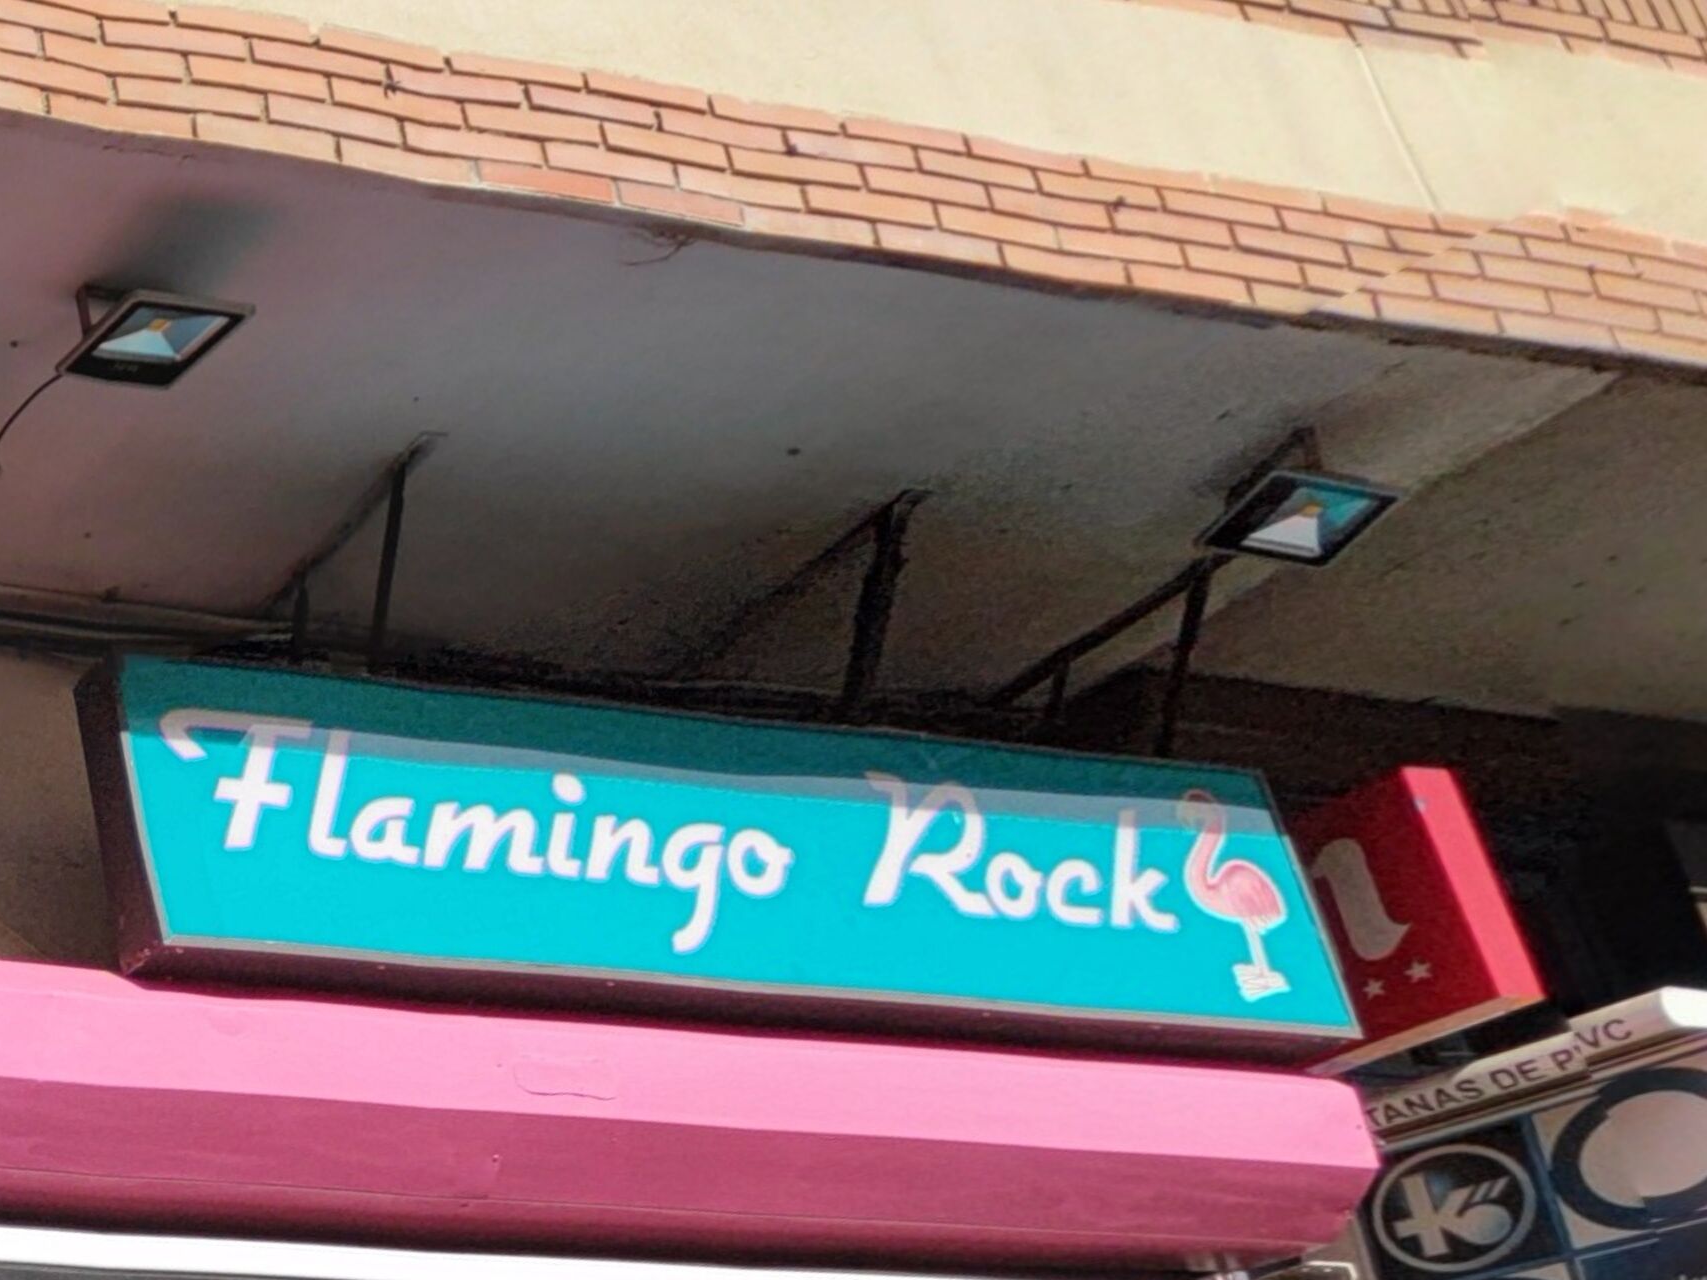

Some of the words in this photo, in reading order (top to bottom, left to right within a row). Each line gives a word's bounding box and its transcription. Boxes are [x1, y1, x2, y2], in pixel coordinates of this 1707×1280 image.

[159, 707, 793, 954] Flamingo
[863, 769, 1181, 933] Rock
[1489, 1059, 1548, 1091] DE
